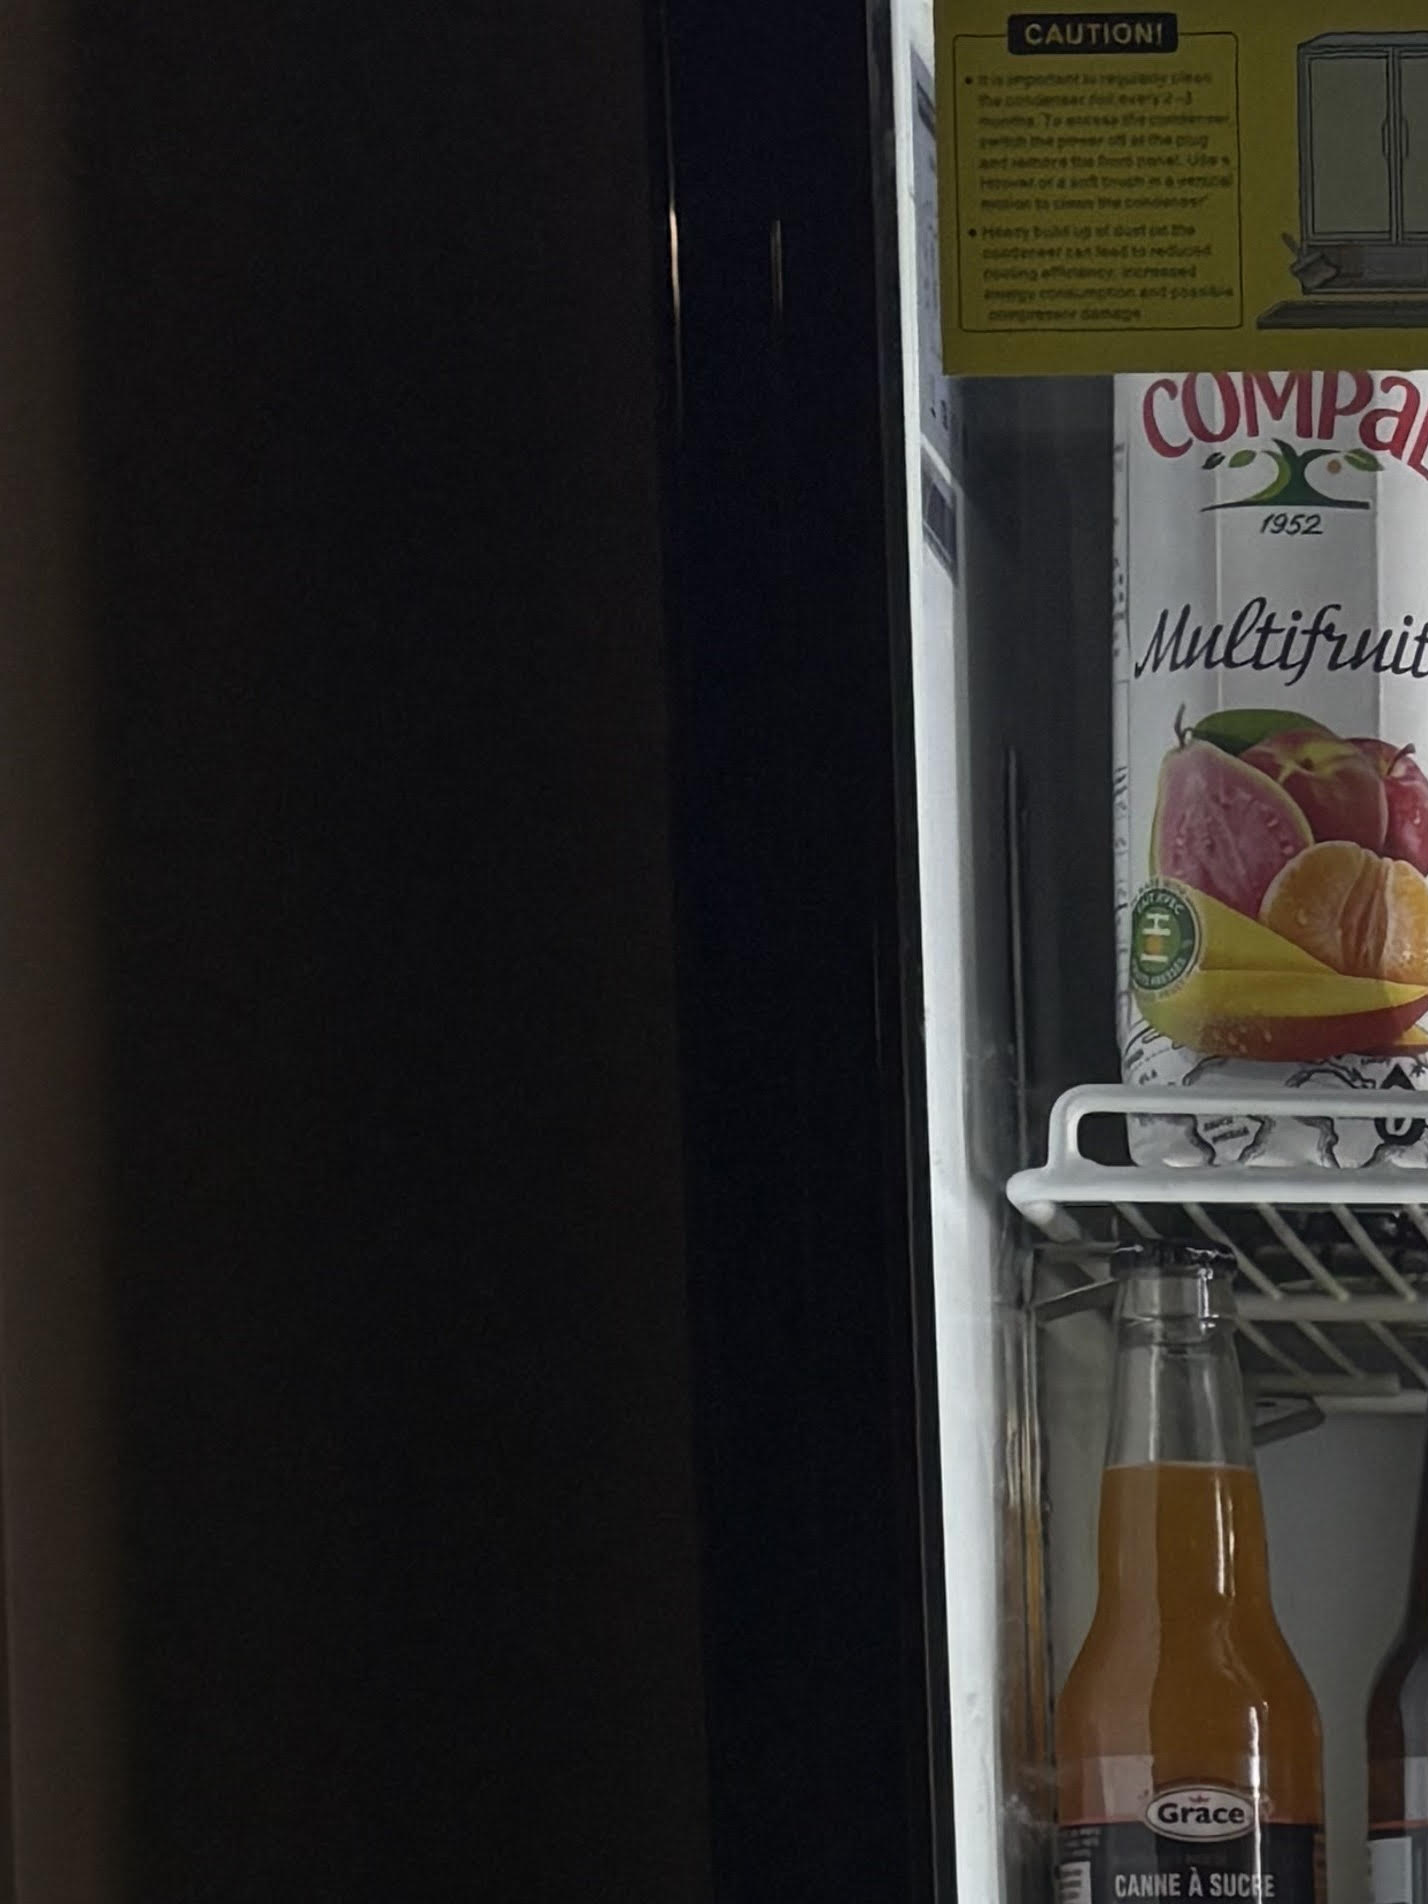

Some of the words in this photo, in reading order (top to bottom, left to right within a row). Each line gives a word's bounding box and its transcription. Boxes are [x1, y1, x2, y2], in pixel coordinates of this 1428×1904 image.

[1025, 23, 1164, 46] CAUTION!
[1259, 512, 1324, 536] 1952
[1157, 1802, 1246, 1826] Grace
[1114, 1871, 1181, 1899] CANNE
[1188, 1865, 1204, 1898] À
[1208, 1872, 1276, 1899] SUCRE
